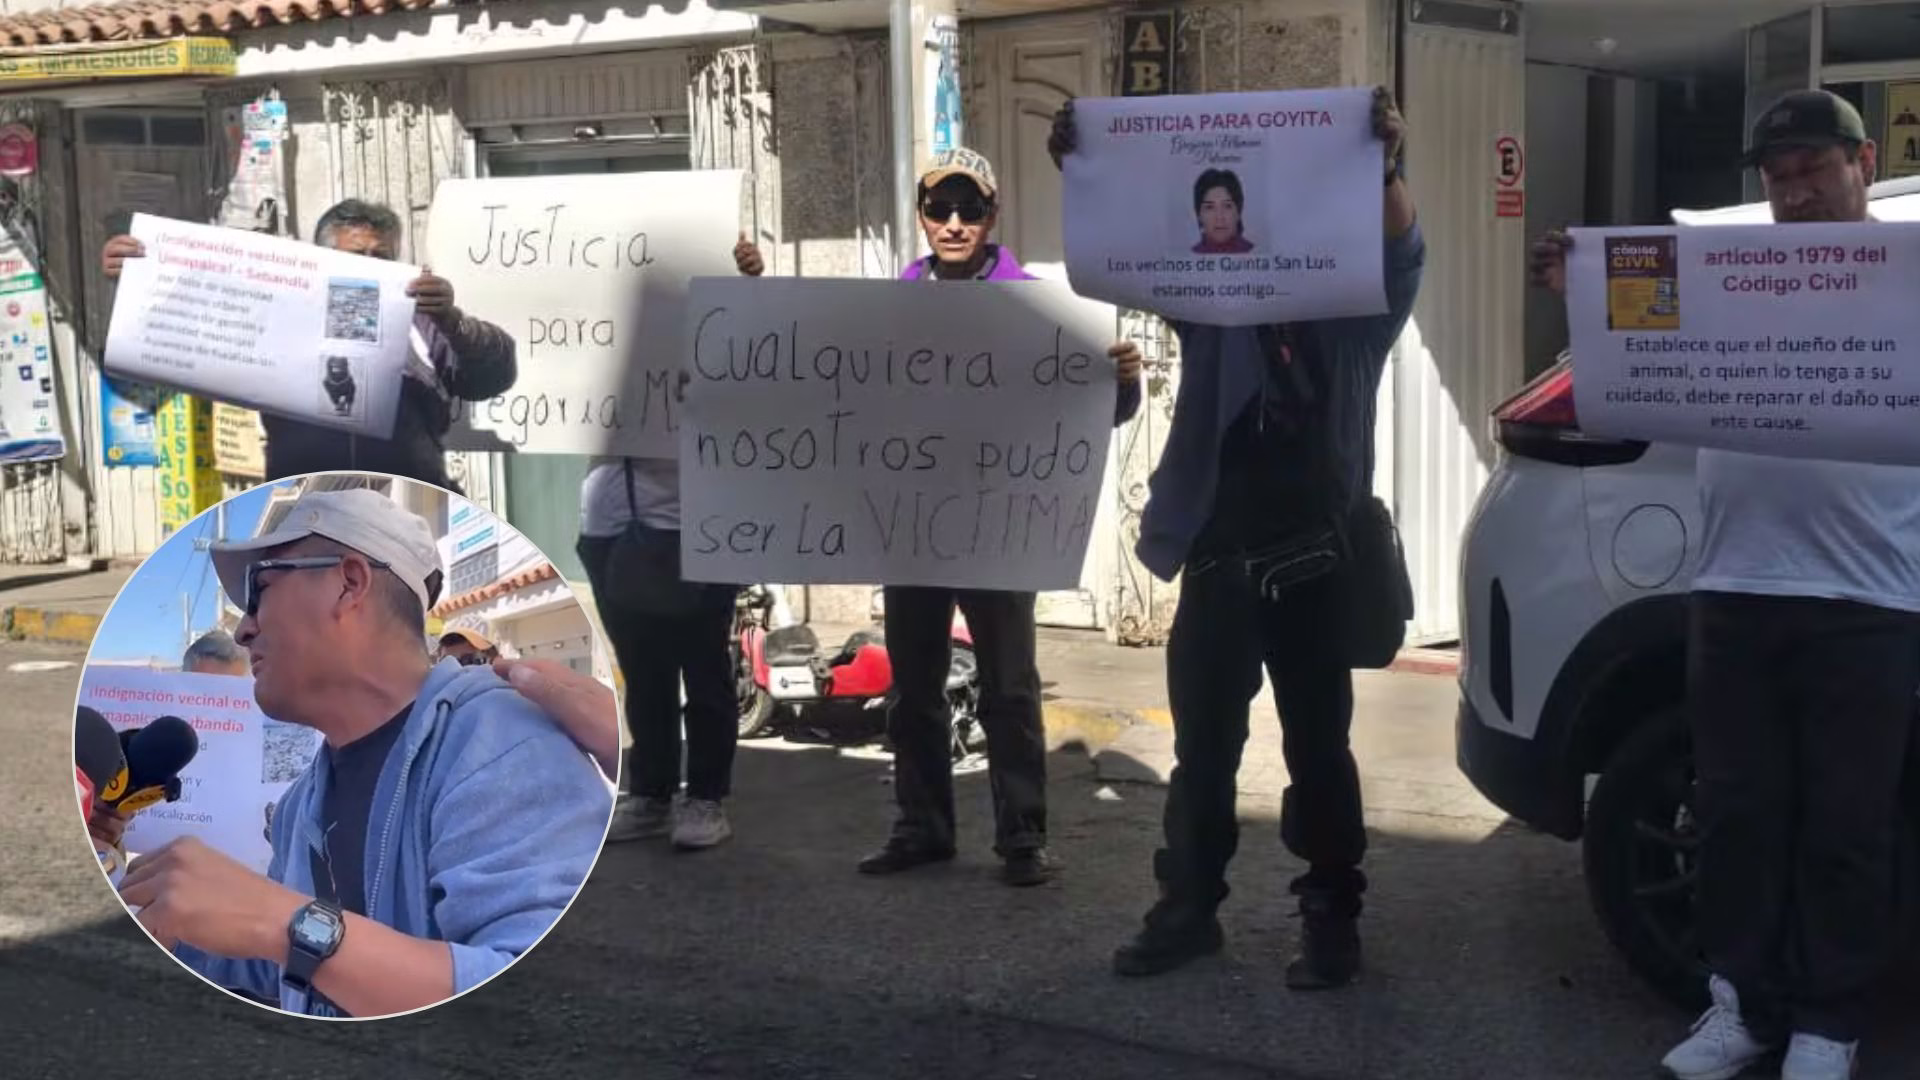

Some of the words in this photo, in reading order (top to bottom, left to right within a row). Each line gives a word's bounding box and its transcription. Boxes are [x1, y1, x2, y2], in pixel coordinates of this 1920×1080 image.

[1108, 114, 1195, 134] JUSTICIA
[1200, 112, 1252, 130] PARA
[1257, 110, 1333, 128] GOYITA
[1107, 257, 1132, 272] Los
[1135, 258, 1192, 272] vecinos
[1196, 257, 1215, 272] de
[1219, 256, 1270, 272] Quinta
[1274, 255, 1301, 270] San
[1306, 254, 1337, 270] Luis
[1612, 255, 1659, 268] CIVIL
[1797, 246, 1846, 264] 1979
[1853, 245, 1887, 263] del
[1152, 284, 1215, 299] estamos
[1722, 273, 1802, 296] Código
[1808, 272, 1858, 291] Civil
[528, 317, 616, 359] para
[1625, 336, 1709, 352] Establece
[1714, 340, 1750, 356] que
[1755, 336, 1771, 352] el
[1777, 336, 1837, 352] dueño
[1842, 336, 1866, 352] de
[1871, 339, 1897, 352] un
[1032, 324, 1091, 387] de
[1629, 362, 1695, 380] animal,
[1699, 366, 1711, 379] o
[1715, 364, 1769, 382] quien
[1774, 363, 1791, 380] lo
[1797, 364, 1850, 383] tenga
[1854, 366, 1866, 380] a
[1871, 366, 1893, 380] su
[1605, 388, 1680, 405] cuidado,
[1686, 388, 1734, 404] debe
[1736, 390, 1804, 408] reparar
[1809, 389, 1825, 405] el
[1831, 388, 1879, 407] daño
[1884, 393, 1920, 410] que
[1711, 414, 1749, 429] este
[975, 421, 1092, 481] pudo
[695, 515, 776, 556] ser
[89, 685, 174, 703] ¡Indignación
[177, 692, 229, 709] vecinal
[232, 699, 251, 710] en
[150, 806, 213, 823] fiscalización
